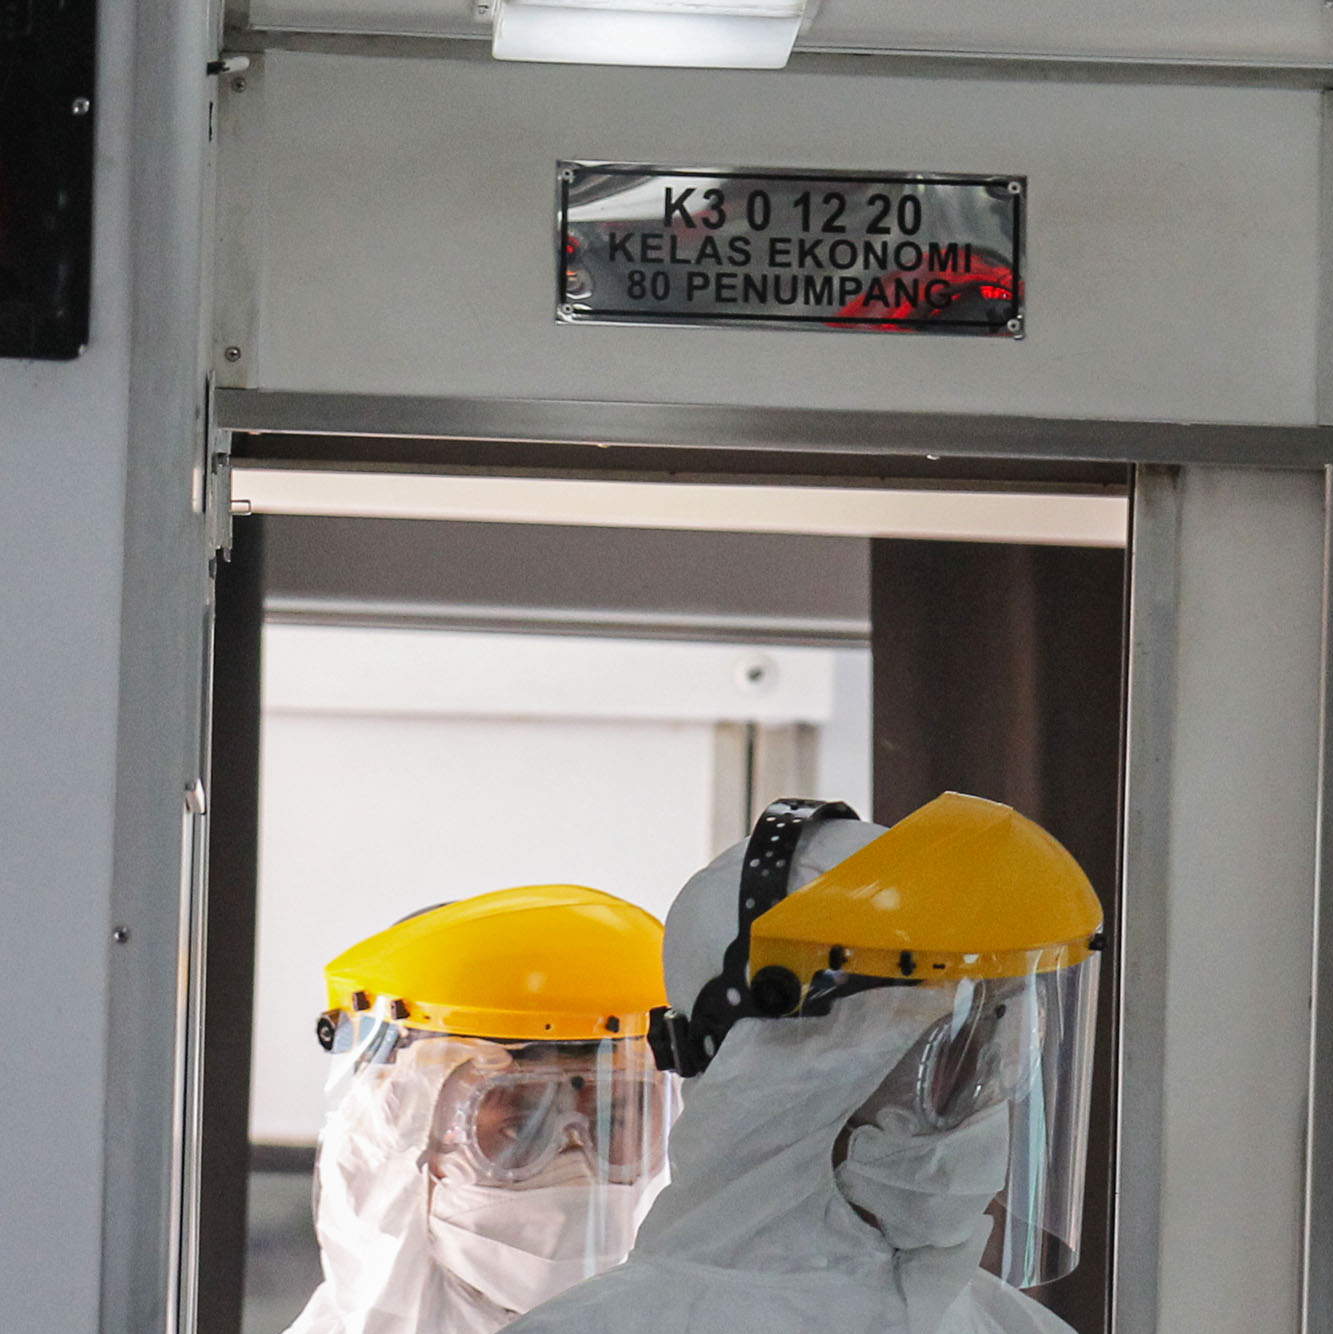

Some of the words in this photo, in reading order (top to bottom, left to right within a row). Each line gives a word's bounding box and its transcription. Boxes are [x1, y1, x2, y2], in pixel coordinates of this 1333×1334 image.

[663, 186, 727, 230] K3
[747, 189, 771, 232] 0
[793, 191, 847, 234] 12
[867, 193, 922, 236] 20
[609, 232, 751, 268] KELAS
[768, 238, 972, 273] EKONOMI
[626, 270, 670, 300] 80
[687, 271, 953, 309] PENUMPANG
